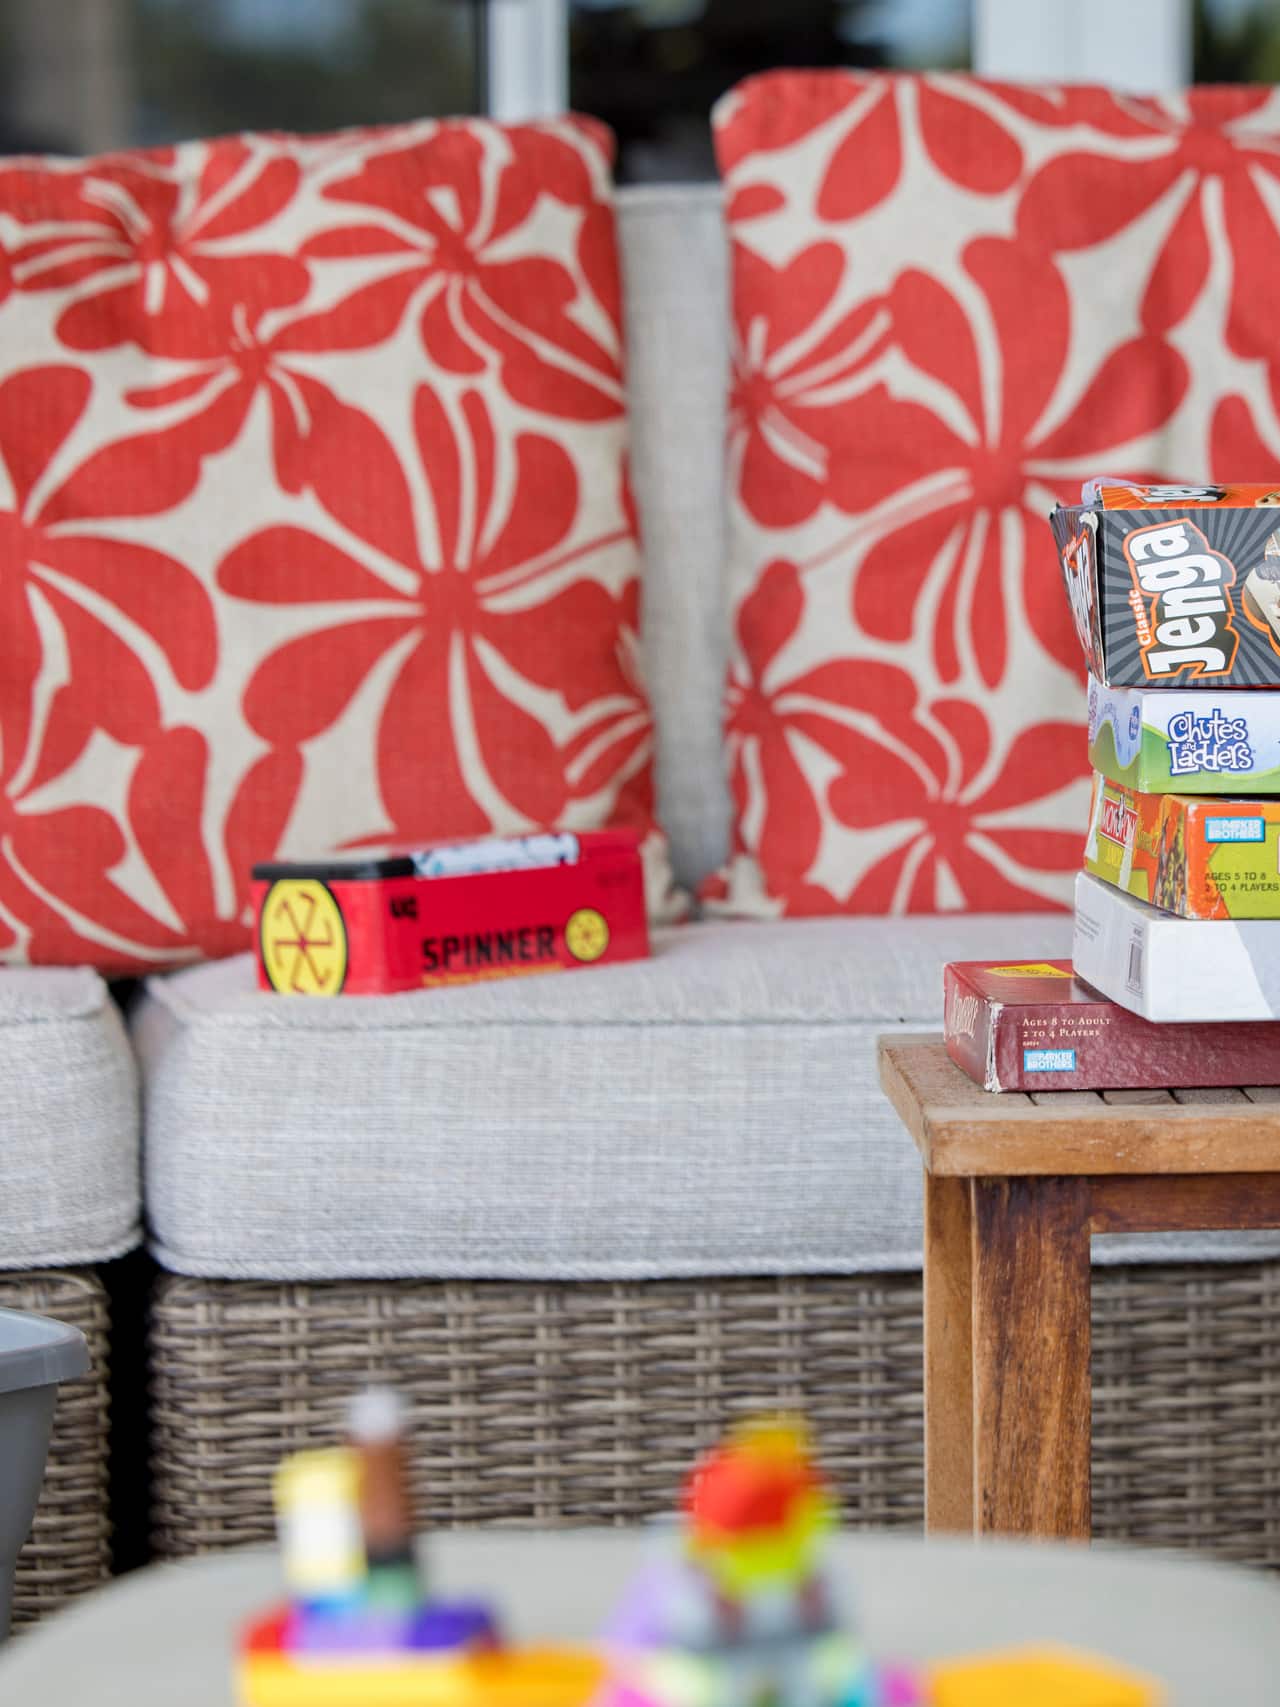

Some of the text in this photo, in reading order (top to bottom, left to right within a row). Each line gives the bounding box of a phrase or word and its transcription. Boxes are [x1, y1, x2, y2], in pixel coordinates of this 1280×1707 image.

[1129, 525, 1226, 674] Jenga
[1129, 590, 1151, 647] Classic
[1168, 708, 1248, 745] Chutes
[1167, 740, 1253, 775] Ladders
[1205, 871, 1231, 881] AGES
[1234, 871, 1240, 881] 5
[1244, 871, 1257, 881] TO
[1215, 883, 1227, 892] TO
[1240, 882, 1280, 892] PLAYERS
[421, 925, 557, 972] SPINNER
